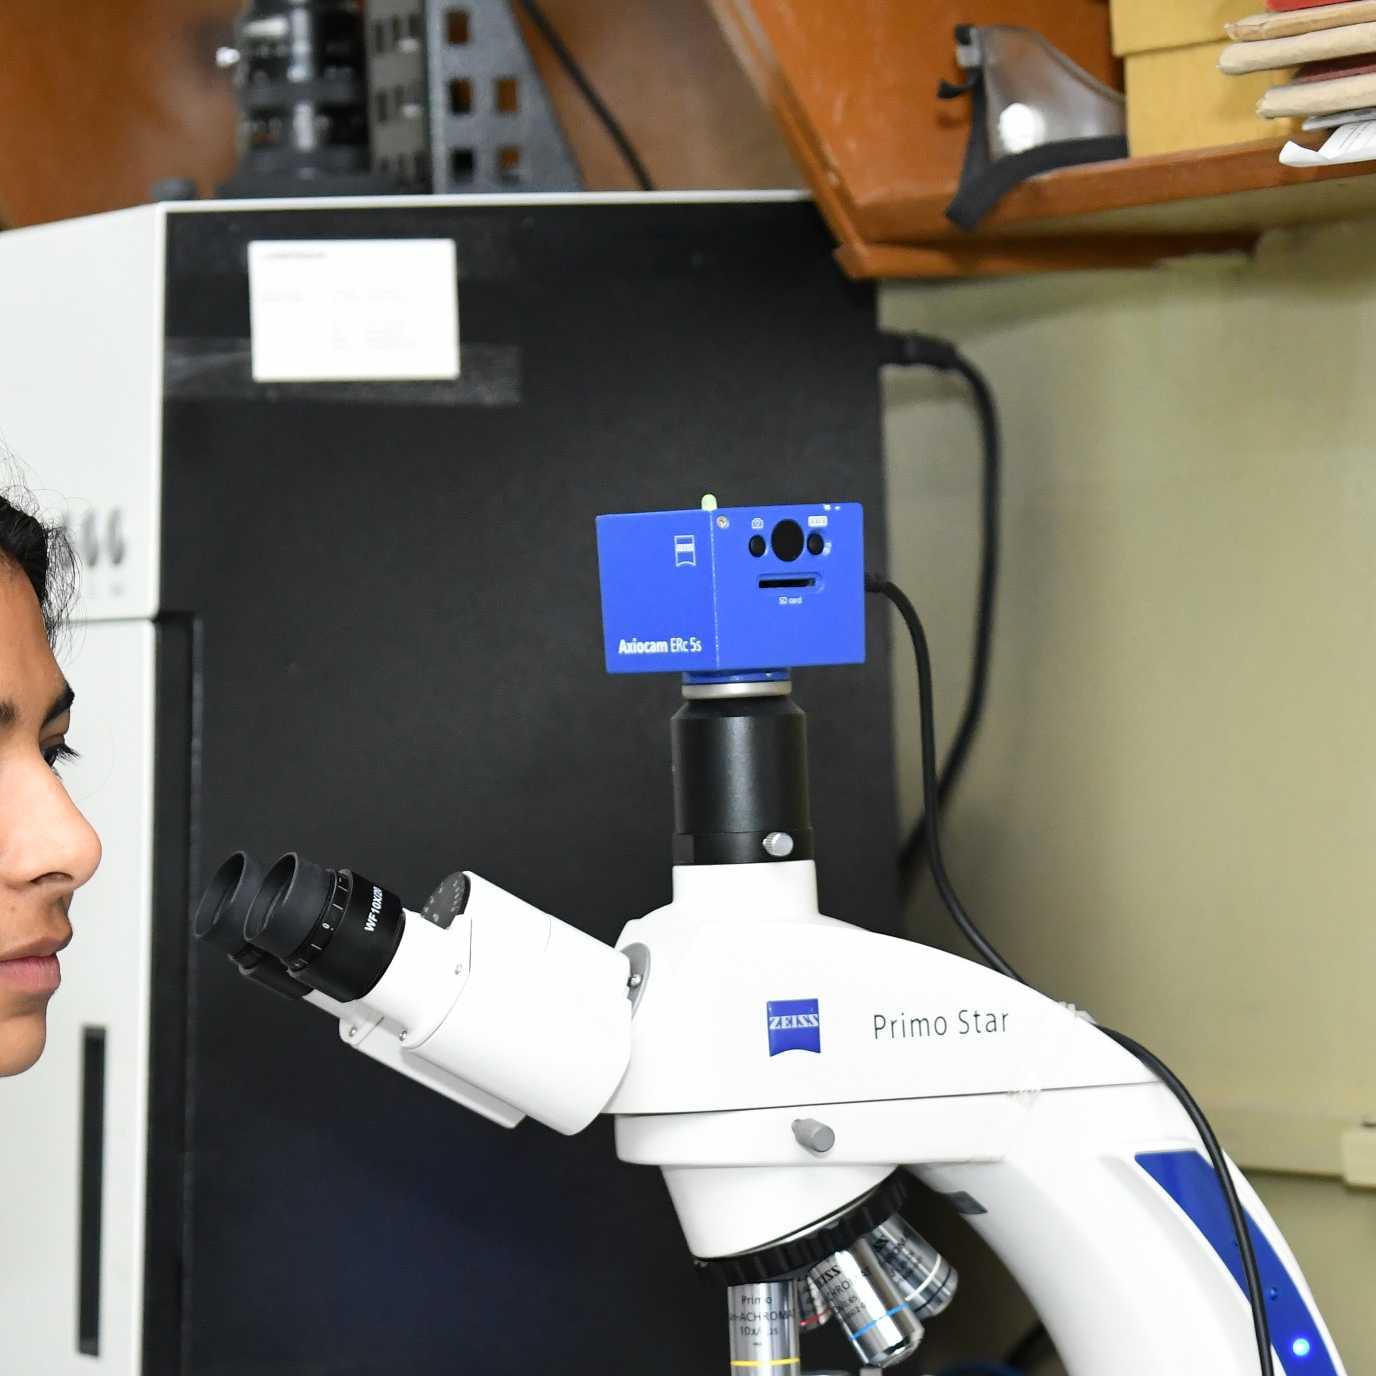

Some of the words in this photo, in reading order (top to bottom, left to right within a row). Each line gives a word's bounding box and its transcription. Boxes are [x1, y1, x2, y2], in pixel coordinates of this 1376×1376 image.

[618, 637, 669, 655] Axiocam
[670, 637, 689, 653] ERc
[689, 636, 702, 653] 5s
[768, 1013, 820, 1030] ZEISS
[873, 1012, 948, 1040] Primo
[959, 1009, 1009, 1035] Star
